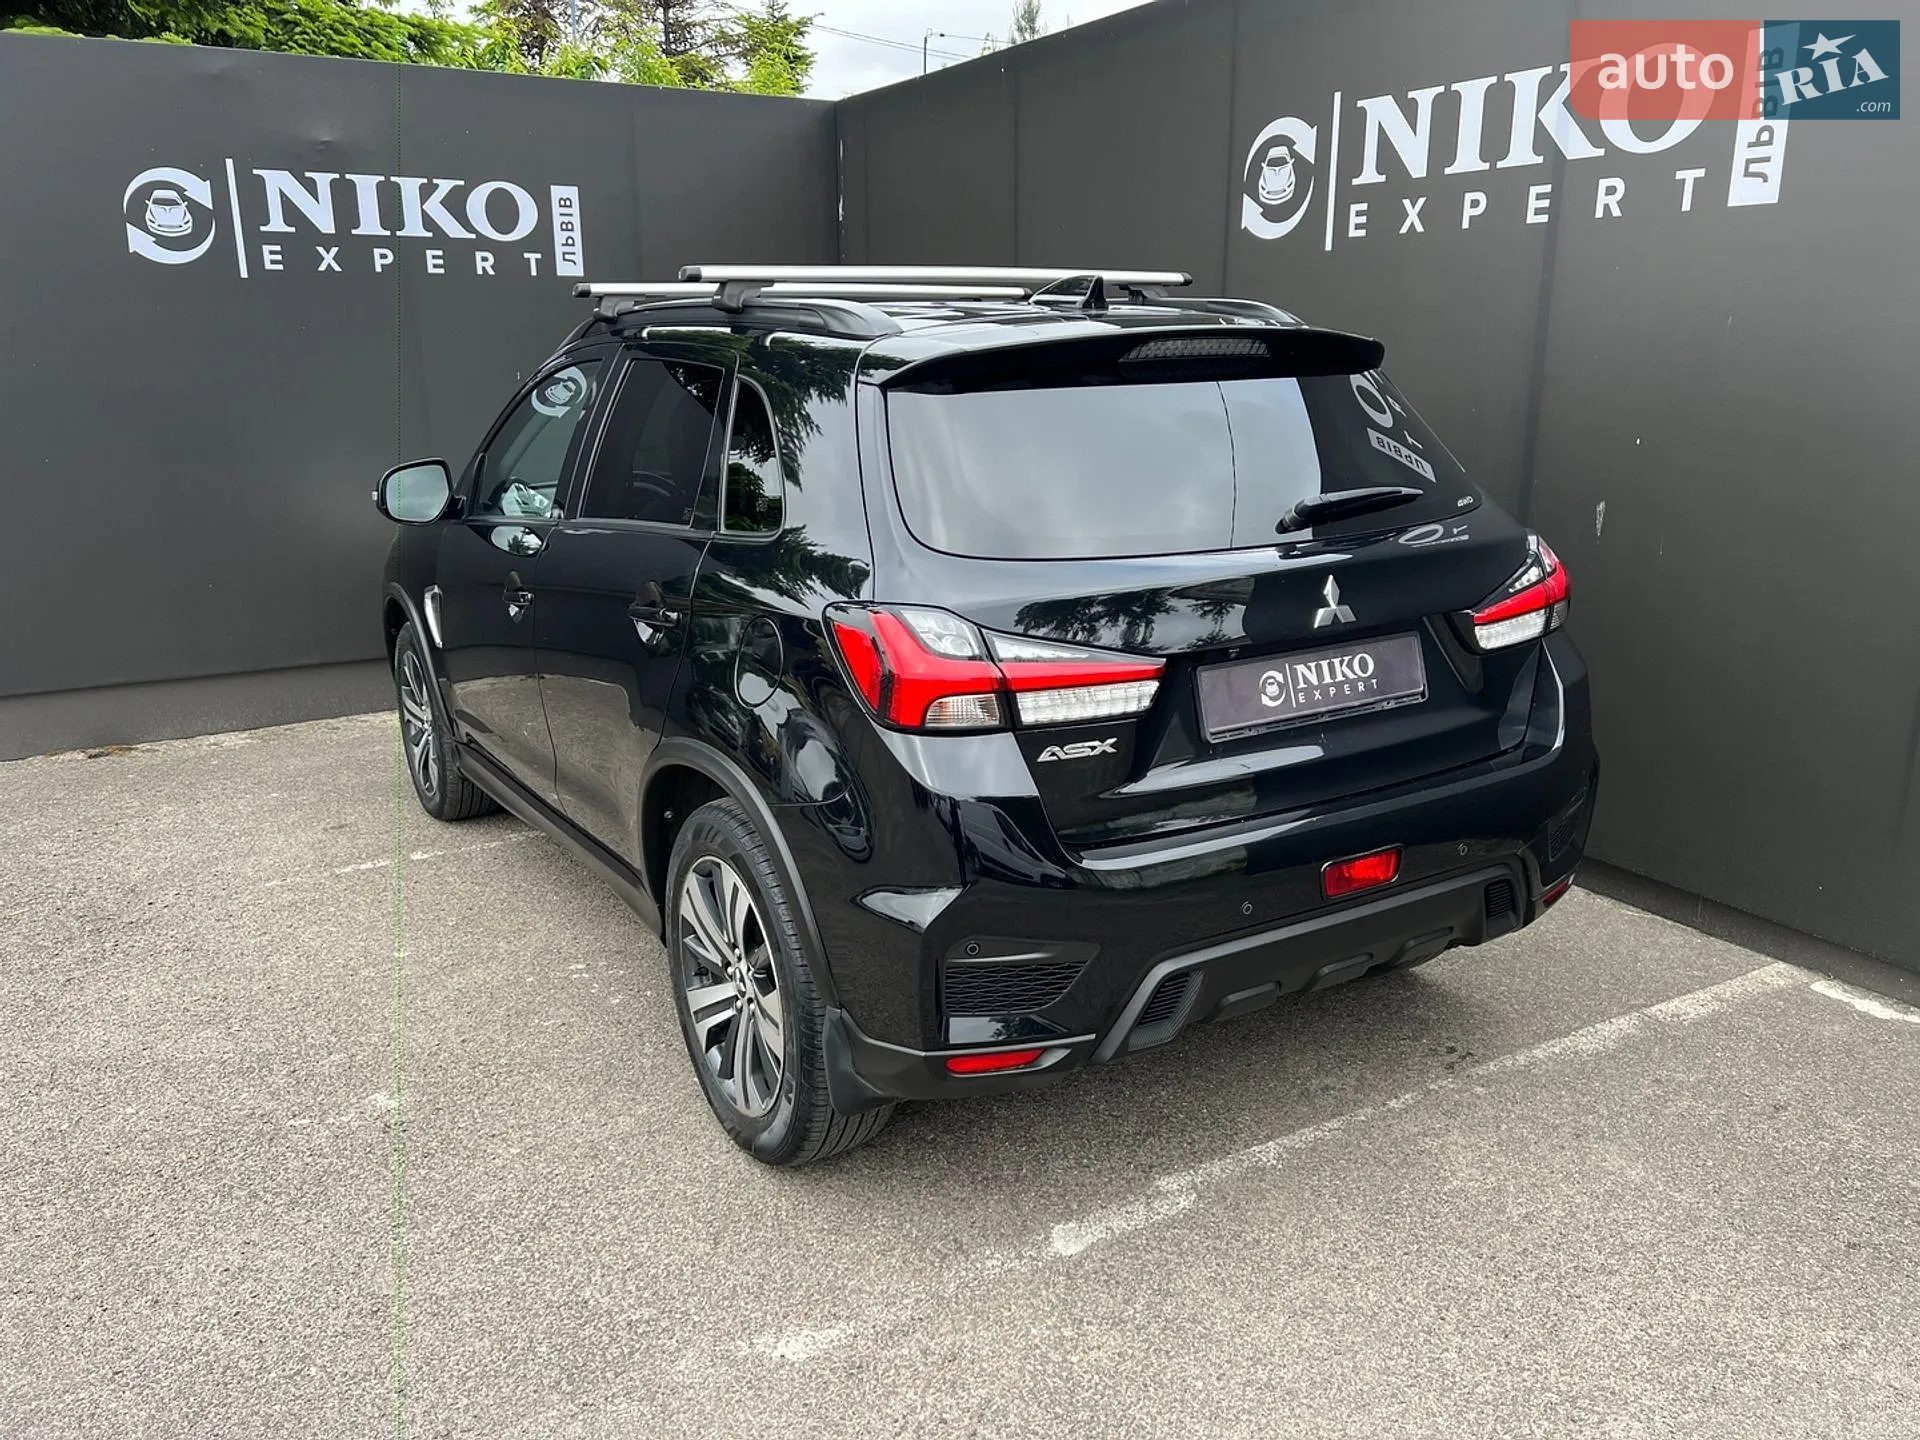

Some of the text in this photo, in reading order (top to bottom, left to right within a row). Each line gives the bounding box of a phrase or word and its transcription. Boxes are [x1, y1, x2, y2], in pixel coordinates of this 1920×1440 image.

[1352, 42, 1712, 187] NIKO
[252, 168, 538, 242] NIKO
[1347, 168, 1706, 238] EXPERT
[558, 195, 577, 265] ЛЬВІВ
[262, 244, 542, 276] EXPERT
[1294, 653, 1375, 690] NIKO
[1299, 678, 1379, 703] EXPERT
[1037, 737, 1118, 762] ASX
